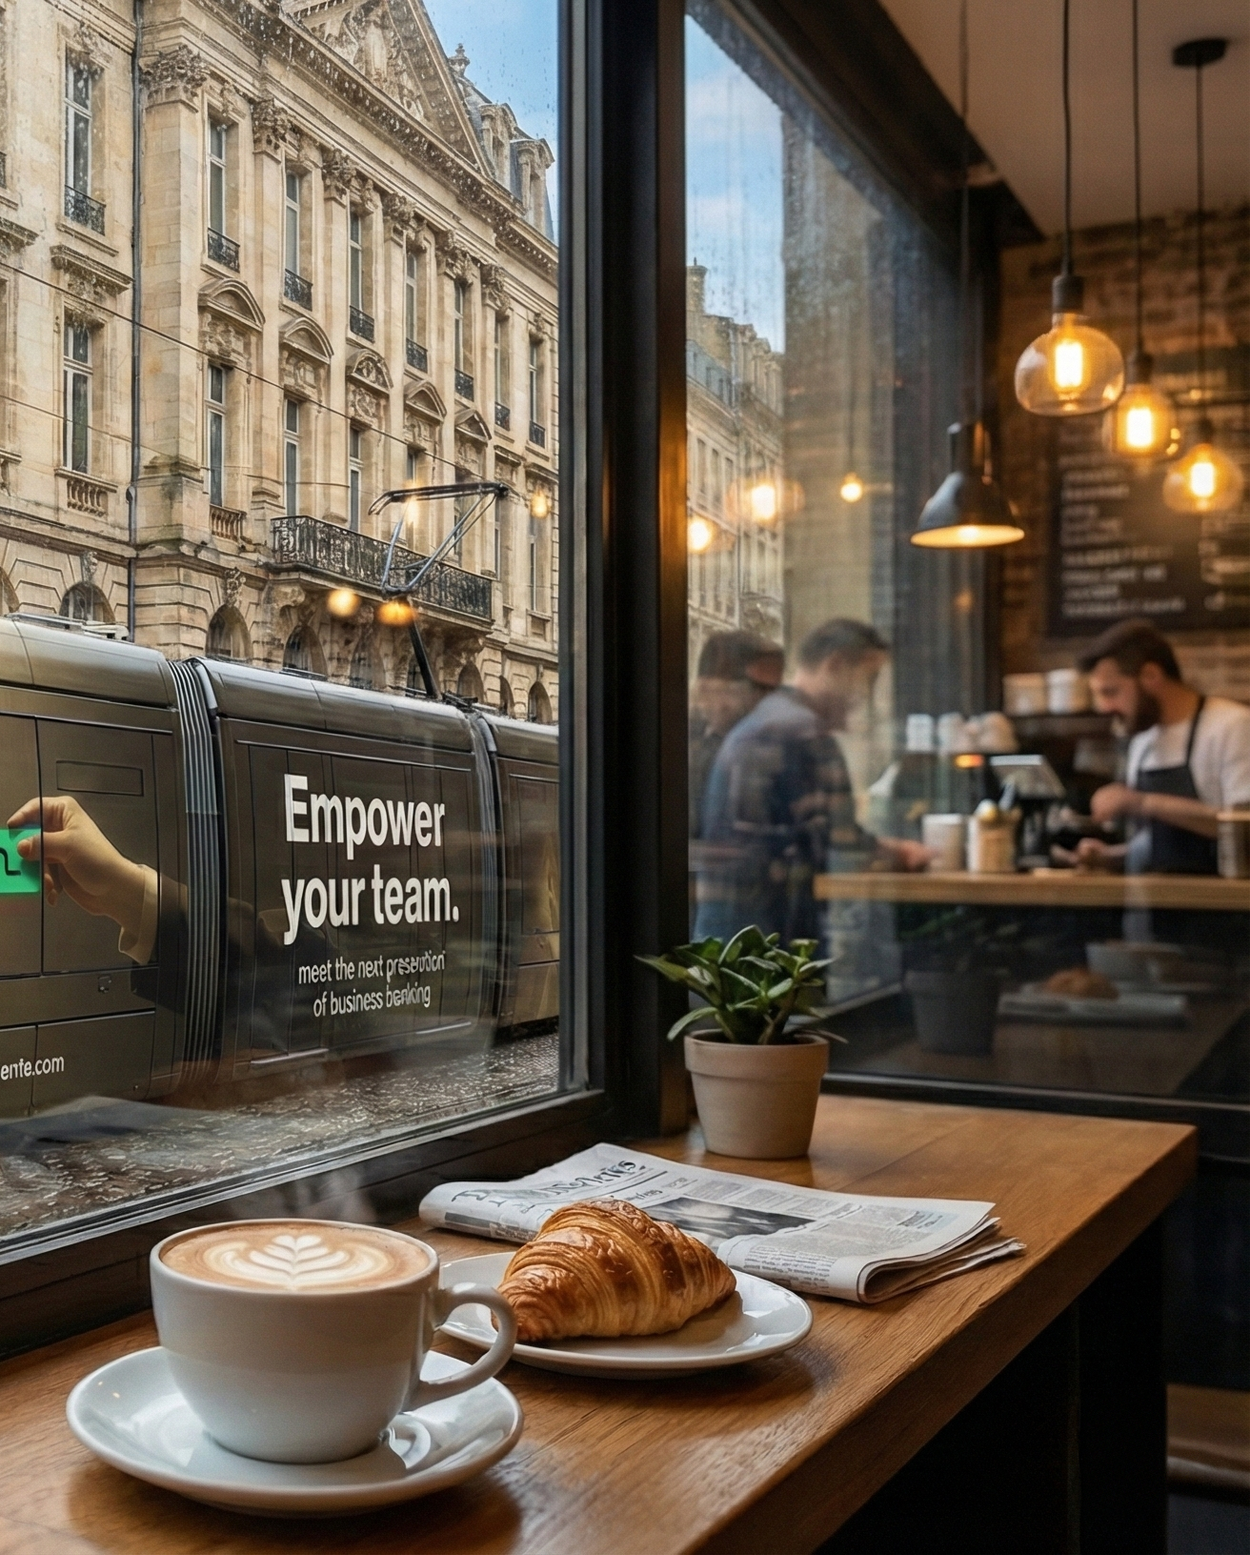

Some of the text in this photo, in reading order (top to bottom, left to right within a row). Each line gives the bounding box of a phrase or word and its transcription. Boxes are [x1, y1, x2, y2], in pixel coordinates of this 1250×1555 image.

[284, 773, 445, 860] Empower
[281, 864, 459, 945] your team.
[298, 959, 332, 984] meet
[335, 956, 355, 981] the
[313, 991, 328, 1017] of
[330, 988, 384, 1016] business
